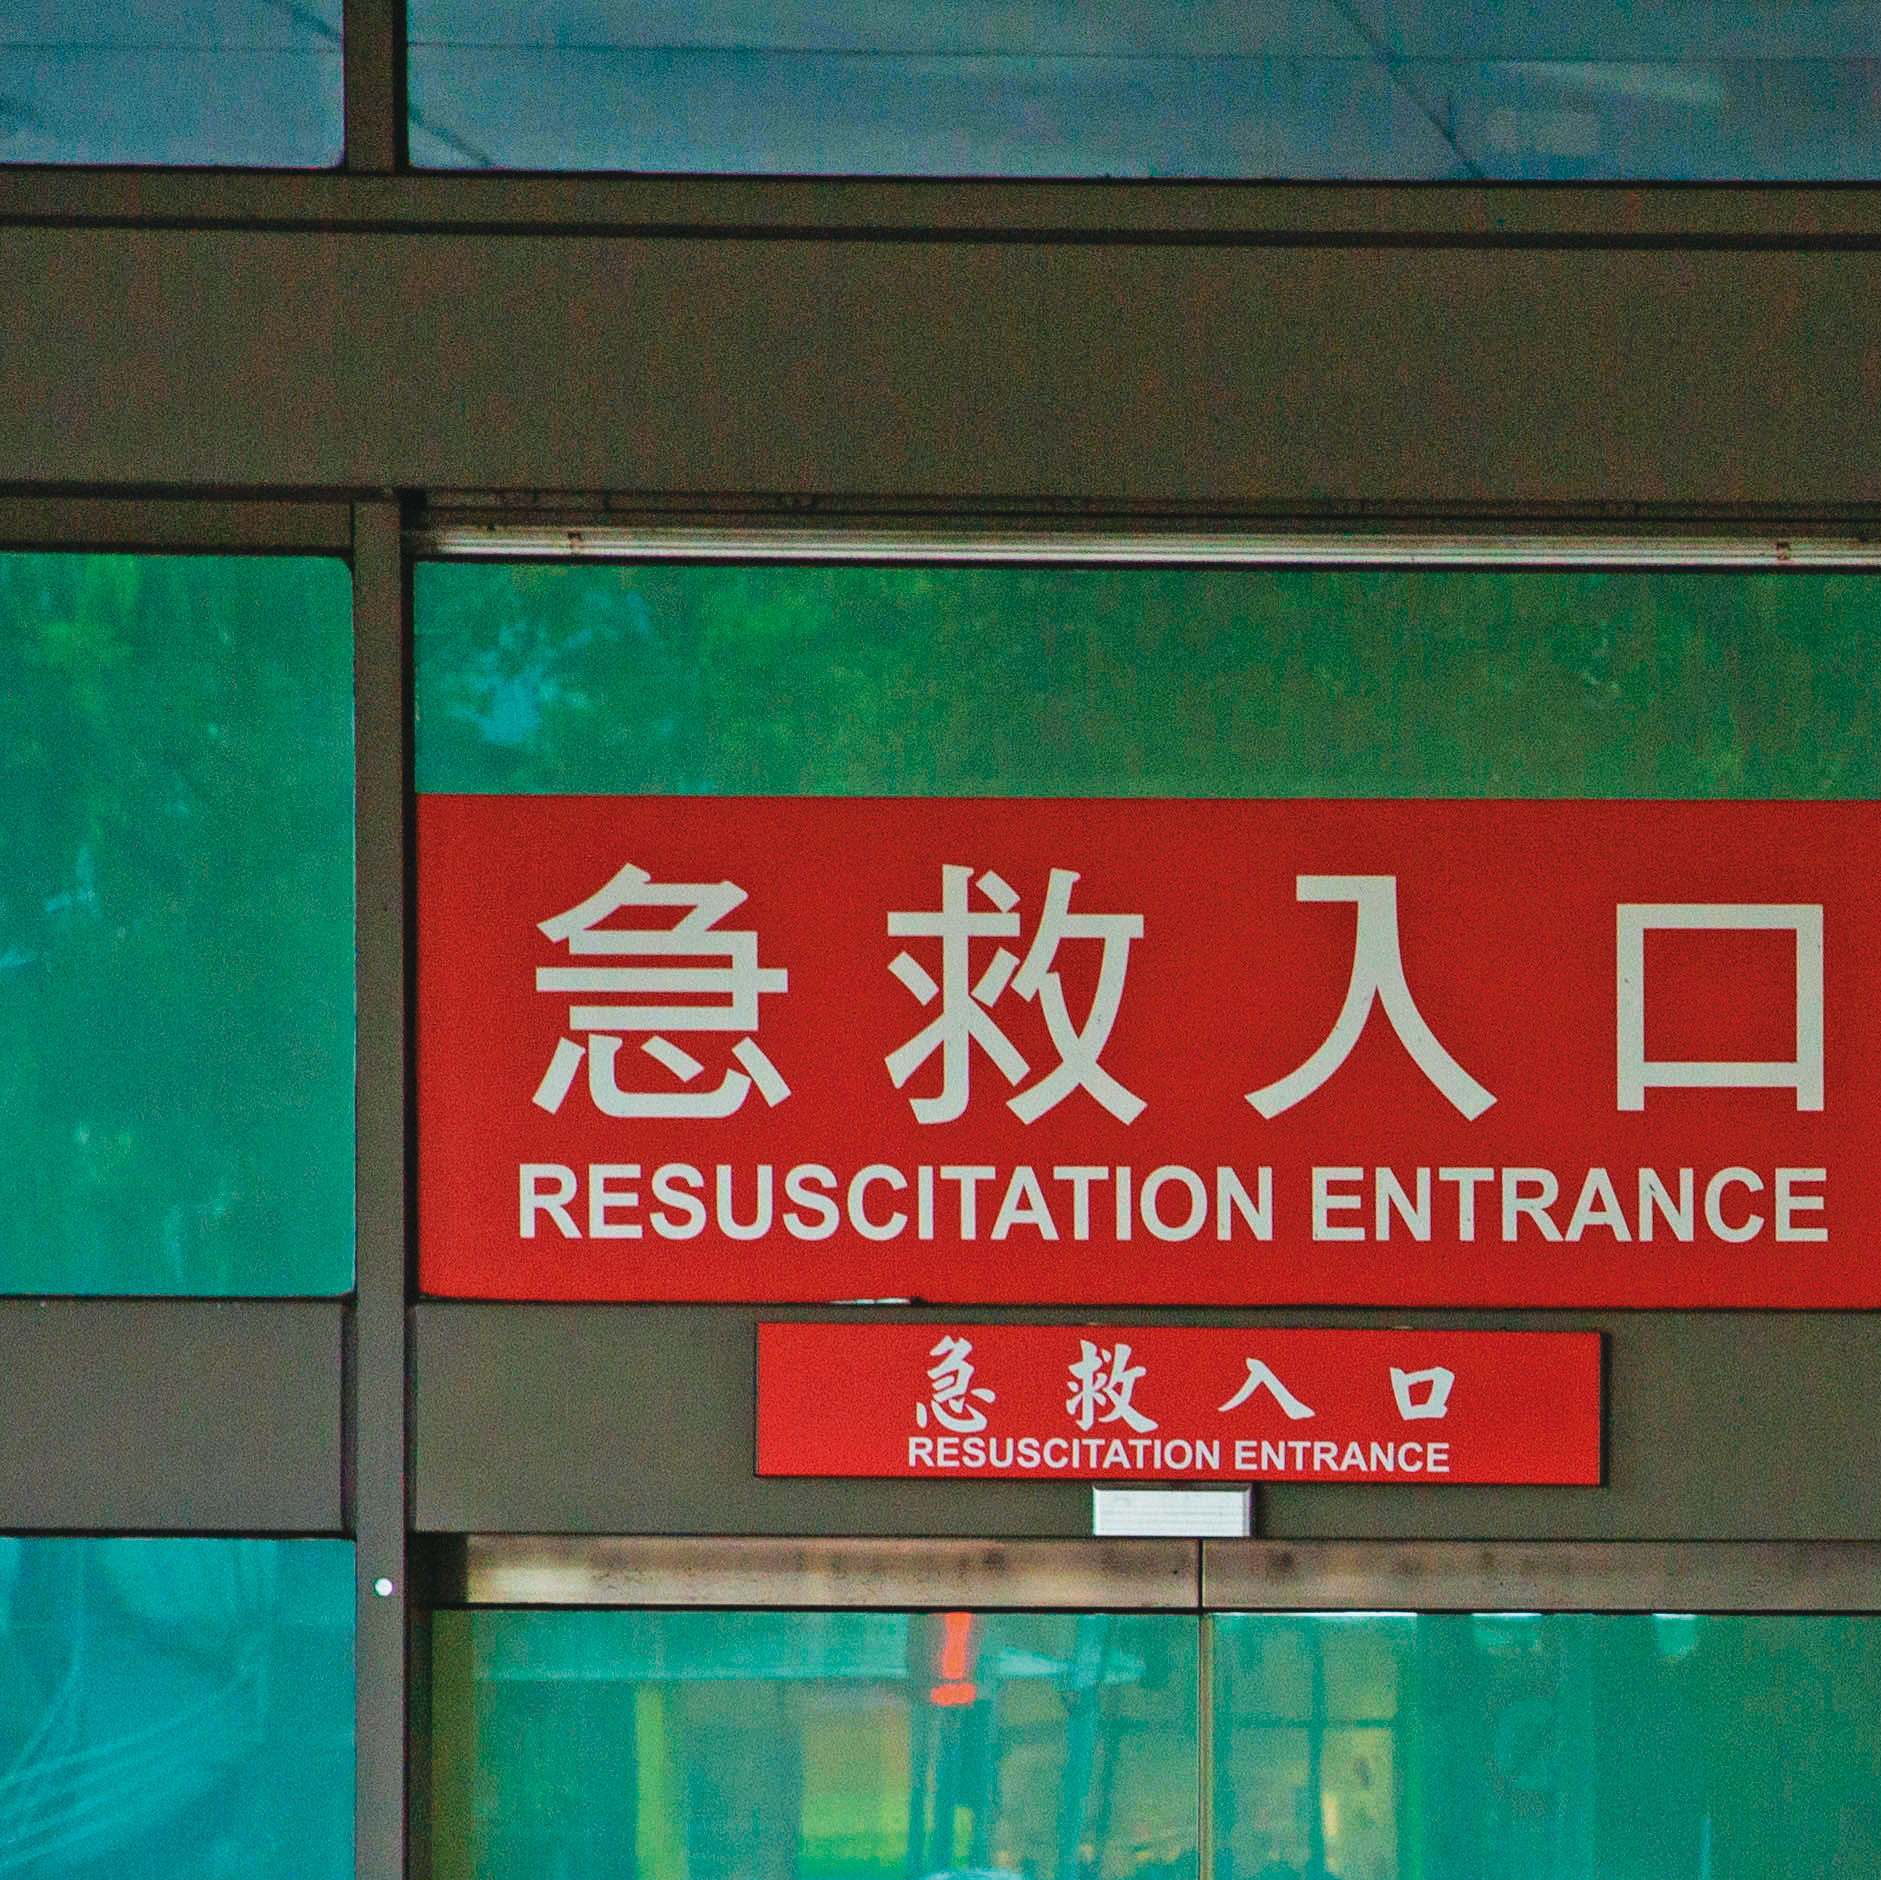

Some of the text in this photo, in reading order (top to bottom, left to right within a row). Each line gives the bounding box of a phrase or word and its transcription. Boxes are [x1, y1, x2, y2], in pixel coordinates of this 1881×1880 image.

[533, 864, 1823, 1124] 急救入口
[520, 1164, 1827, 1242] RESUSCITATION ENTRANCE
[917, 1336, 1455, 1433] 急救入口
[909, 1437, 1449, 1472] RESUSCITATION ENTRANCE
